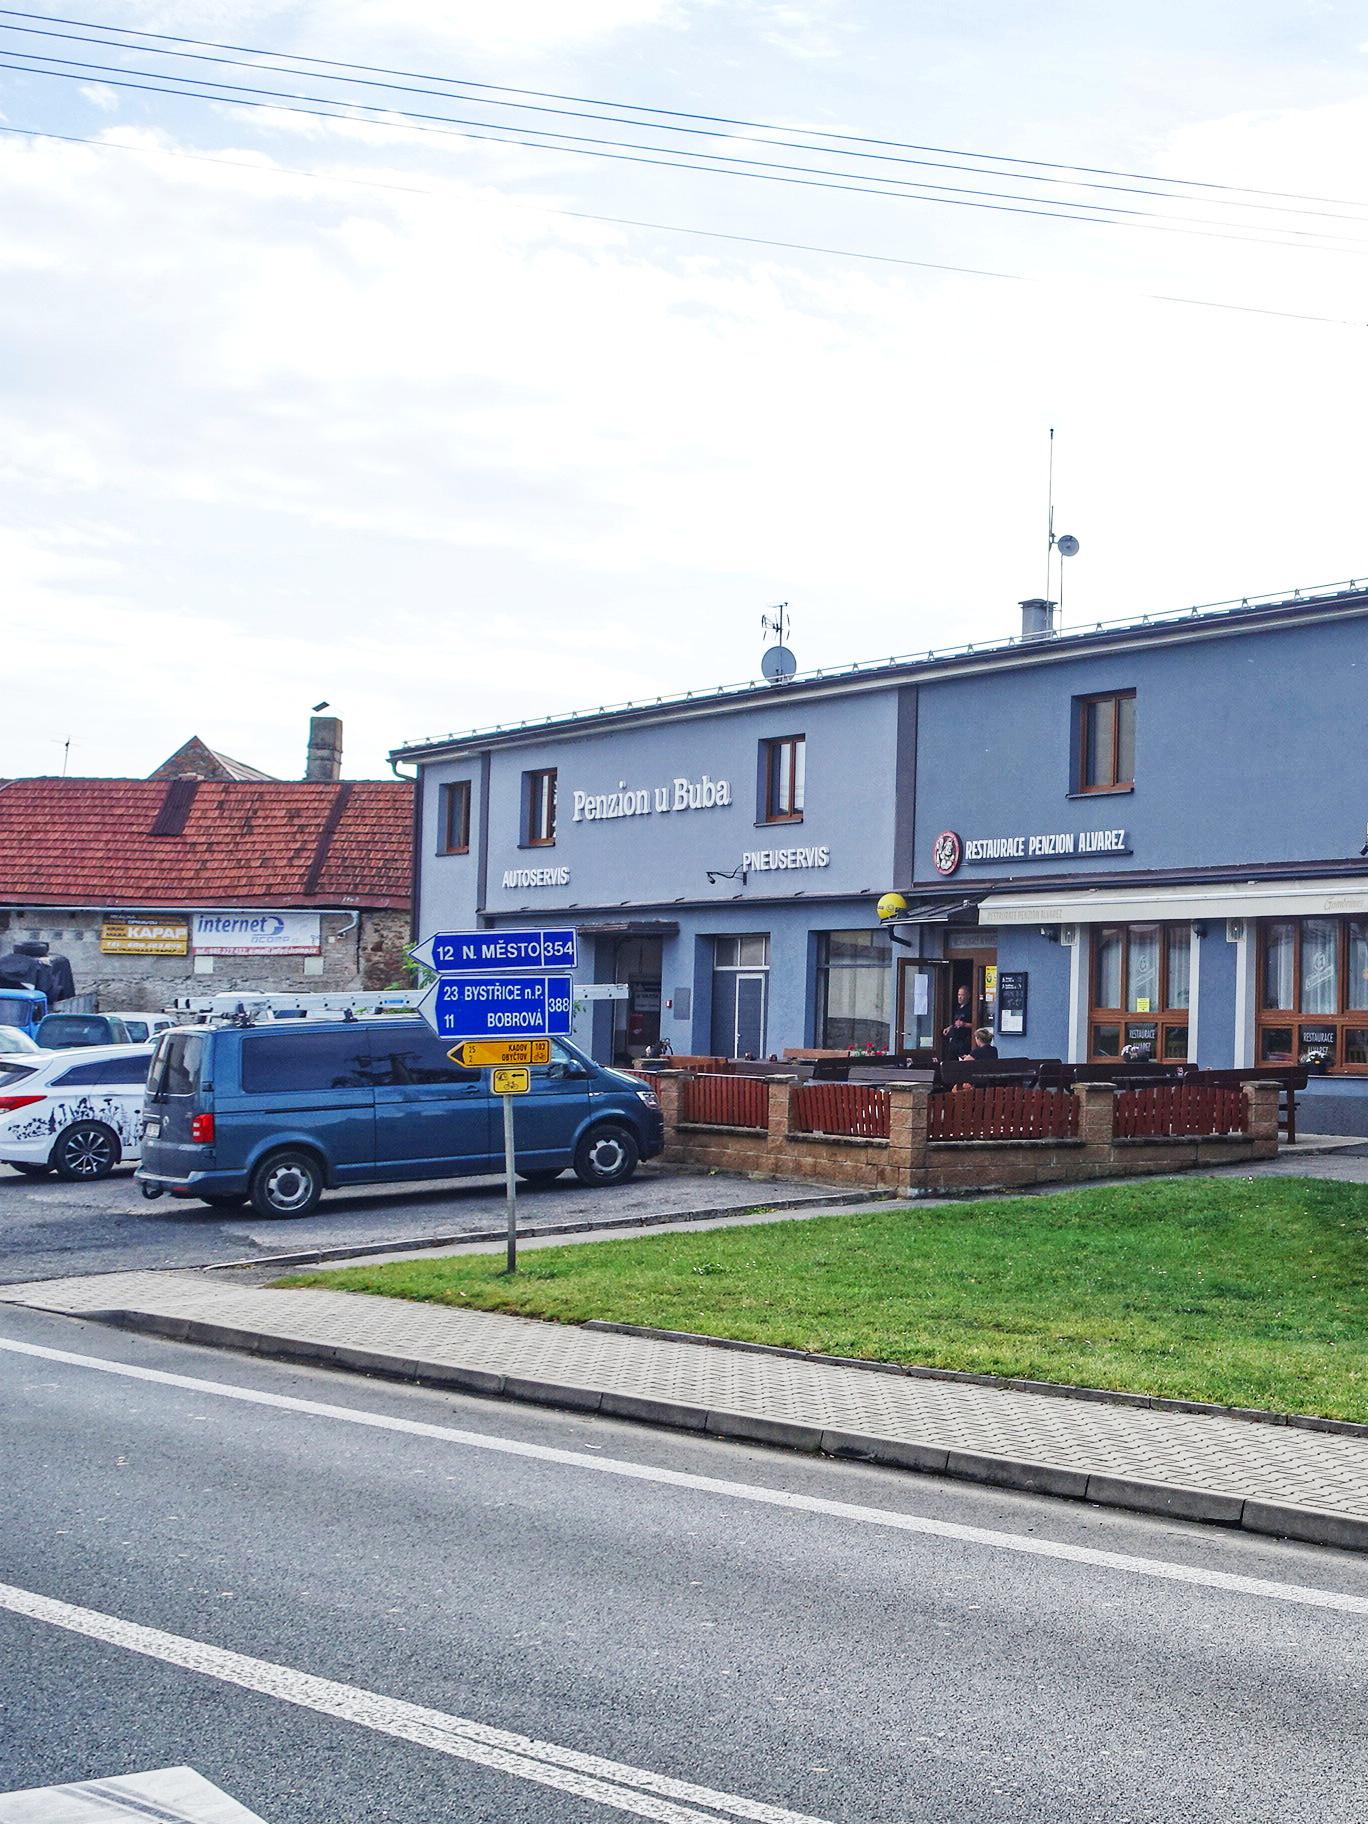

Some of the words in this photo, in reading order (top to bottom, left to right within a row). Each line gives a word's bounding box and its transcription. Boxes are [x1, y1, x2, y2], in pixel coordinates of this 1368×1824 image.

[572, 780, 650, 822] Penzion
[654, 788, 670, 812] u
[673, 775, 732, 812] Buba
[965, 836, 1025, 860] RESTAURACE
[1028, 833, 1074, 856] PENZION
[1078, 829, 1126, 852] ALVAREZ
[742, 846, 830, 872] PNEUSERVIS
[502, 866, 570, 888] AUTOSERVIS
[198, 915, 268, 933] internet
[437, 945, 454, 961] 12
[462, 945, 477, 960] N.
[482, 940, 541, 959] MĚSTO
[543, 941, 574, 956] 354
[444, 986, 459, 1001] 23
[464, 983, 521, 1001] BYSTŘICE
[525, 985, 544, 1000] n.P.
[549, 998, 570, 1013] 388
[444, 1014, 455, 1028] 11
[487, 1008, 543, 1028] BOBROVÁ
[1303, 1032, 1334, 1043] RESTAURACE
[501, 1052, 528, 1061] OBYČTOV
[508, 1044, 528, 1052] KADOV
